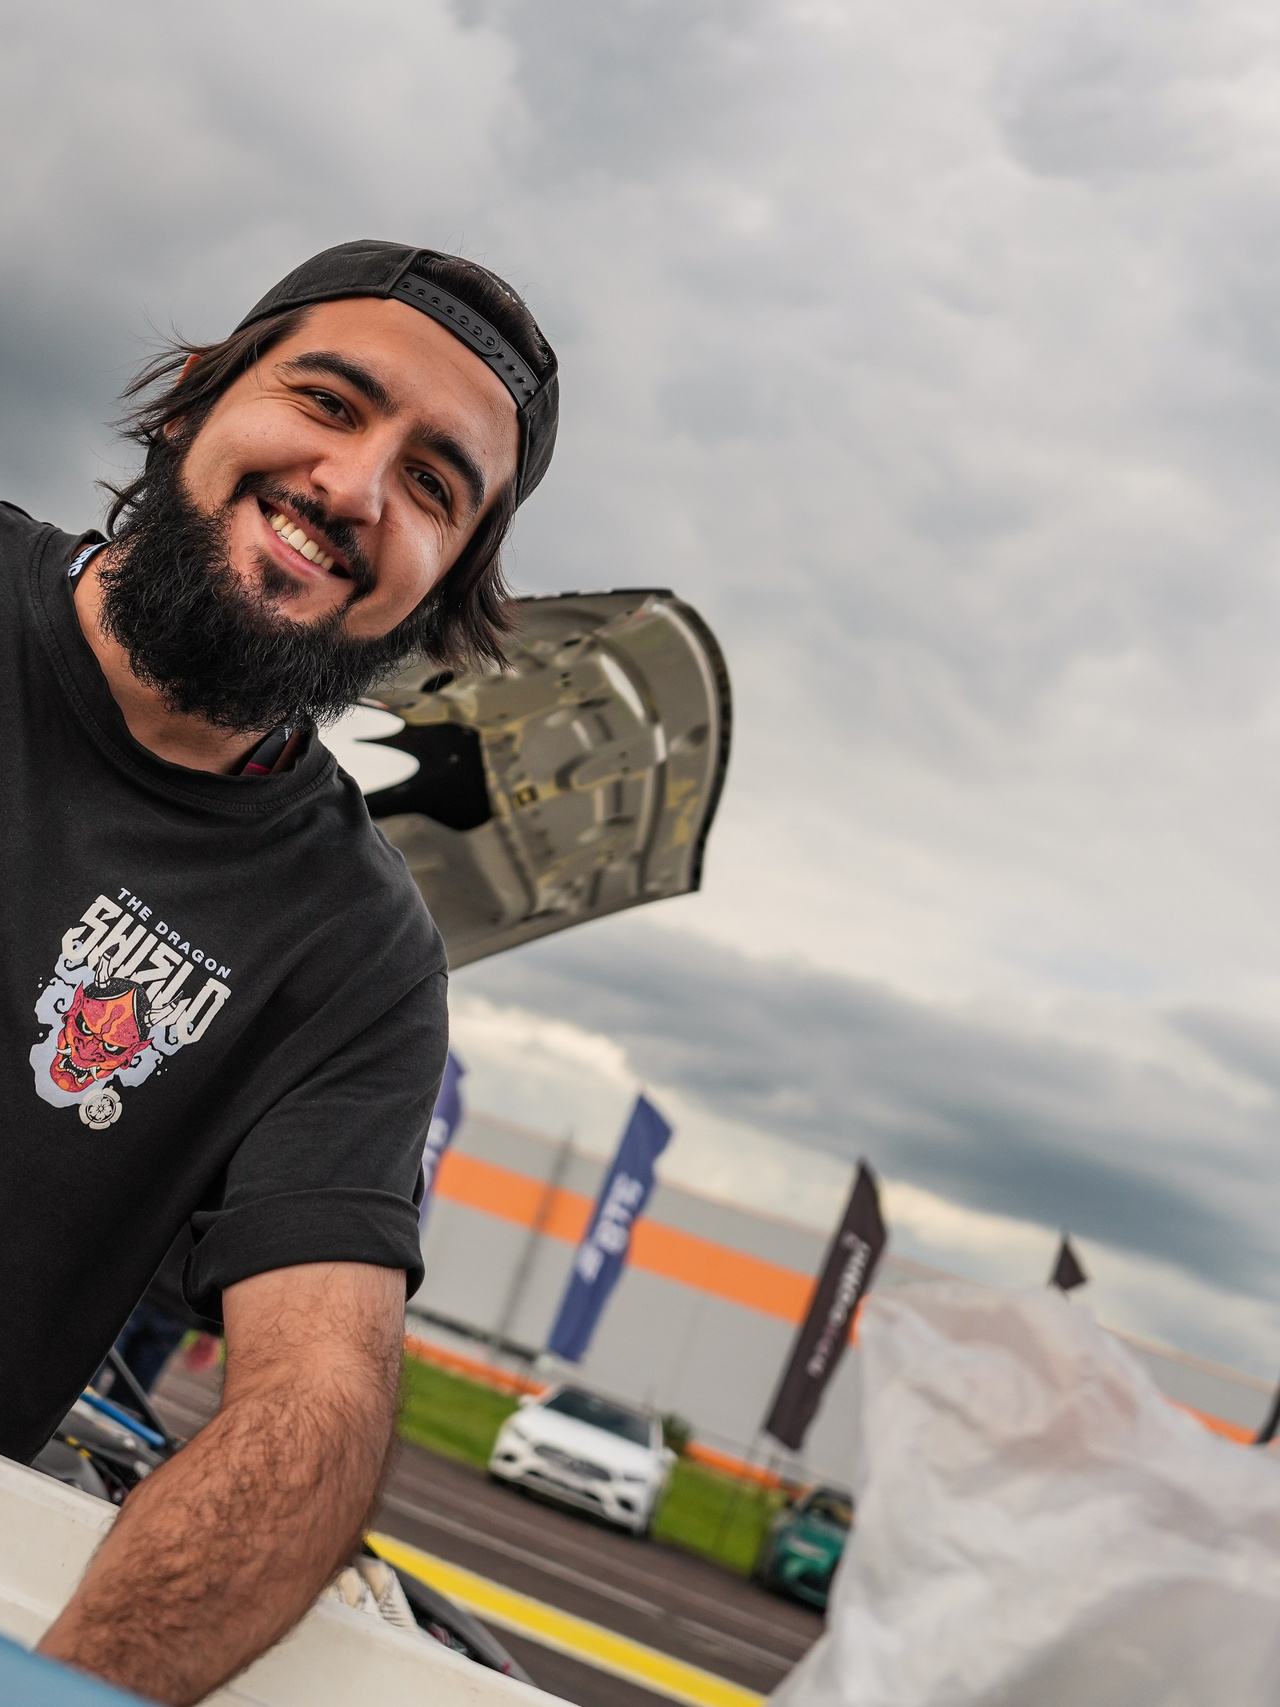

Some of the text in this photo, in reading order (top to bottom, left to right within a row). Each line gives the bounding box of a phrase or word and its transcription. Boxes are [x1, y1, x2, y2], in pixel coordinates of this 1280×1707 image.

[61, 894, 232, 1045] SHIELD
[117, 888, 232, 979] THE DRAGON
